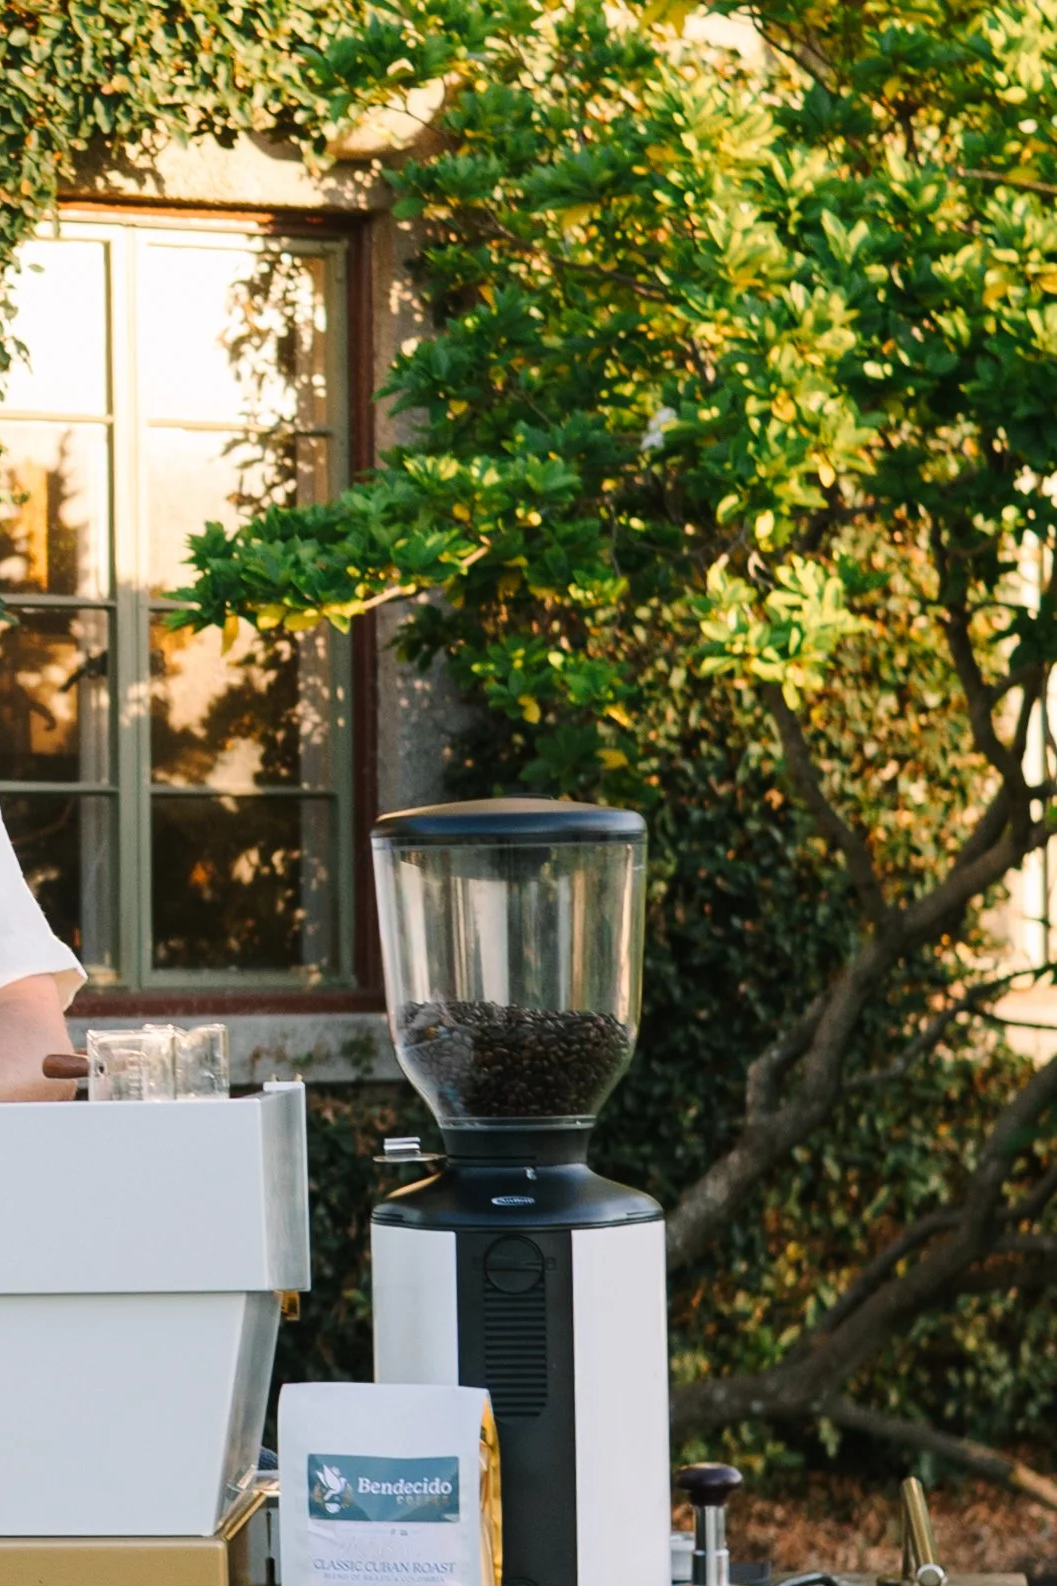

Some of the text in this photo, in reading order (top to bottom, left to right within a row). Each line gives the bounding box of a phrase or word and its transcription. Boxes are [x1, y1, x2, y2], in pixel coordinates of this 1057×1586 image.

[357, 1477, 453, 1496] Bendecido
[313, 1558, 456, 1574] CLASSIC CUBAN ROAST
